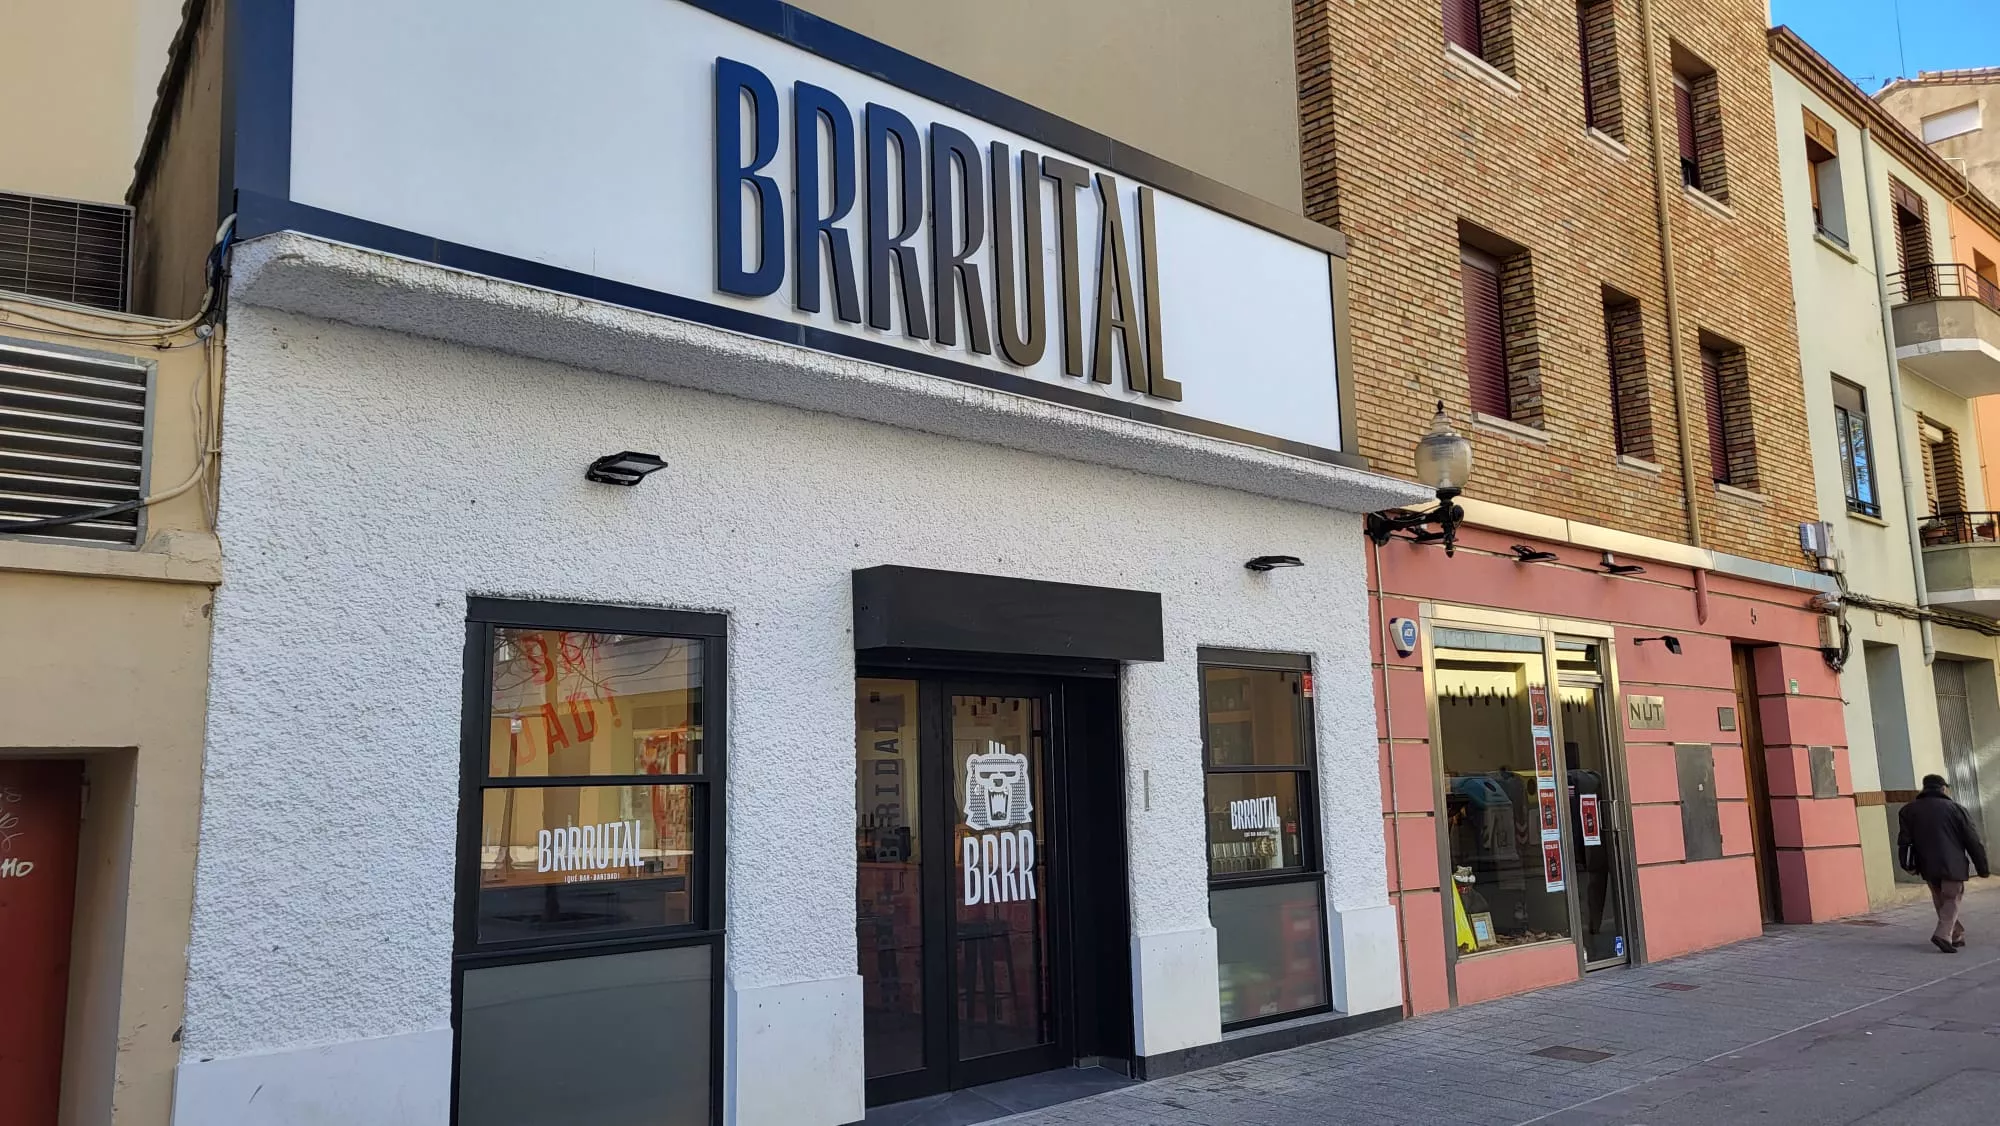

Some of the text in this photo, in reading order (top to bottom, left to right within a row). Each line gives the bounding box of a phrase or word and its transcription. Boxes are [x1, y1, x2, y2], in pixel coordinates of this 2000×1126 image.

[712, 55, 1183, 402] BRRRUTAL
[1630, 702, 1662, 721] NUT
[1230, 795, 1280, 830] BRRRUTAL
[537, 819, 645, 872] BRRRUTAL
[963, 829, 1036, 906] BRRR
